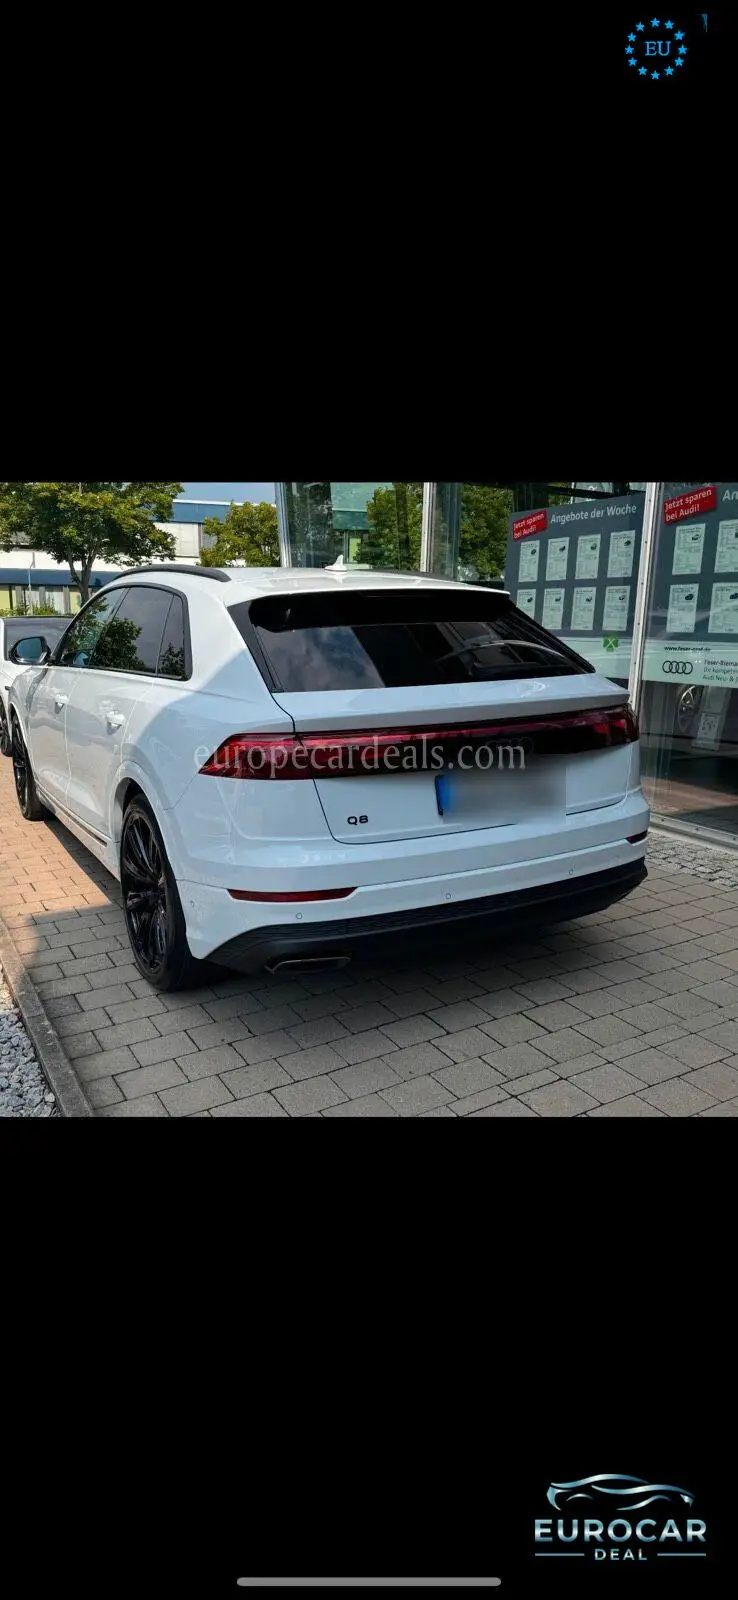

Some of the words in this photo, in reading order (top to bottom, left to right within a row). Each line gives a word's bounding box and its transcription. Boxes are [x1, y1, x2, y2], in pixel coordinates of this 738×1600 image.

[664, 498, 684, 513] Jetzt
[685, 489, 712, 504] sparen
[526, 512, 544, 525] sparen
[551, 511, 589, 525] Angebote
[590, 508, 605, 519] der
[606, 503, 637, 516] Woche
[665, 510, 678, 522] bei
[679, 503, 700, 518] Audi!
[347, 814, 369, 826] Q8
